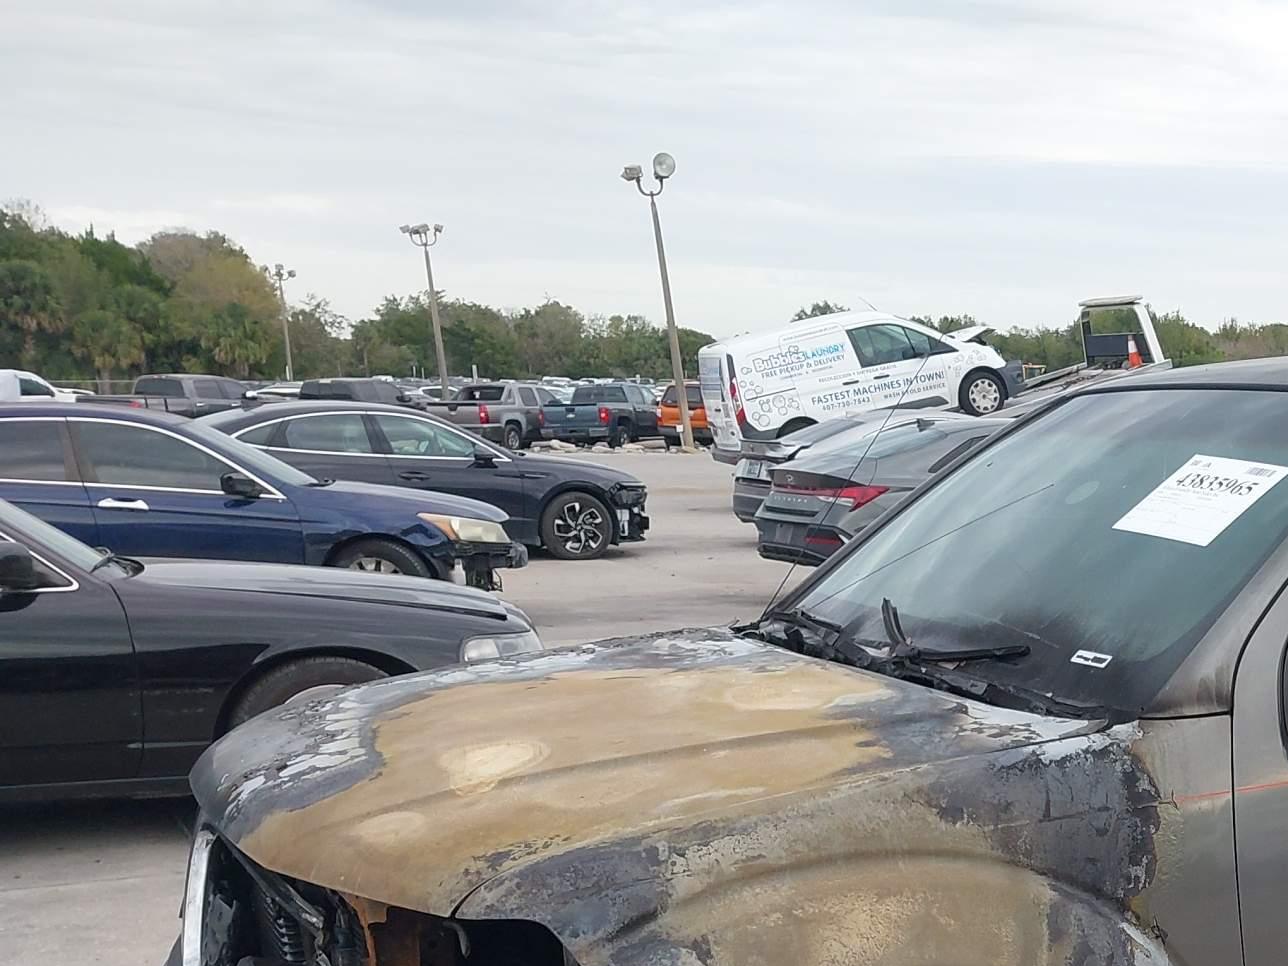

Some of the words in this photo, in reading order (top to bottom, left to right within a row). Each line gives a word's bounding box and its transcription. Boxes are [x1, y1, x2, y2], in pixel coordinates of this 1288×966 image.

[752, 350, 806, 373] Bubbles
[805, 343, 845, 359] LAUNDRY
[761, 369, 778, 379] FREE
[780, 362, 805, 375] PICKUP
[806, 361, 812, 369] &
[814, 354, 845, 367] DELIVERY
[811, 389, 851, 405] FASTEST
[853, 380, 902, 397] MACHINES
[903, 376, 912, 386] IN
[914, 370, 945, 384] TOWN!
[1176, 472, 1260, 496] 43835965
